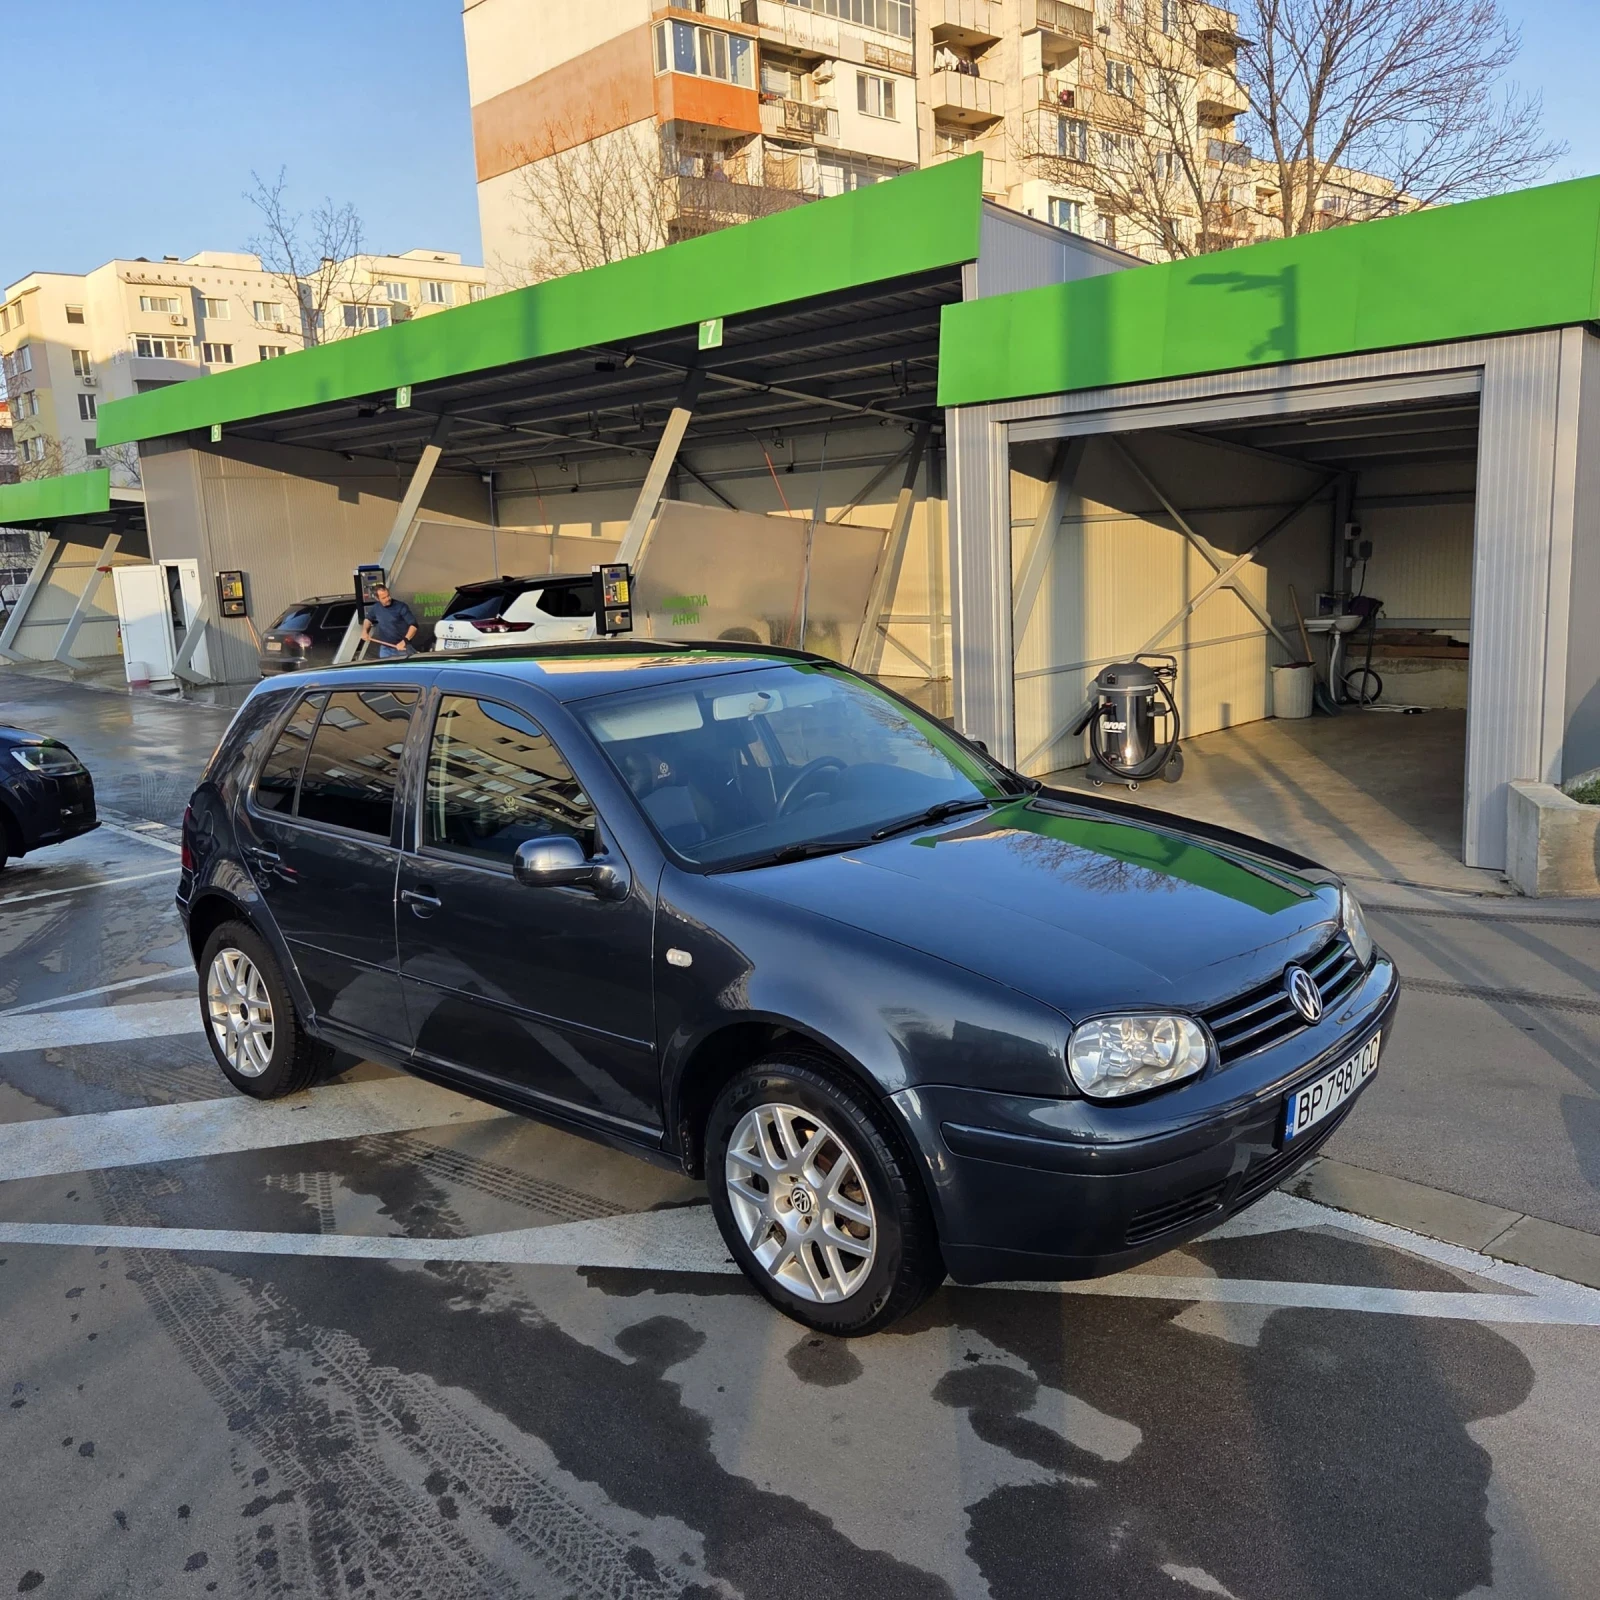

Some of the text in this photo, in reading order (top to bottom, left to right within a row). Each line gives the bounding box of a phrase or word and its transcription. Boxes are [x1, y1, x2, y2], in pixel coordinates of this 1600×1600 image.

[706, 320, 716, 344] 7
[400, 387, 407, 405] 6
[214, 424, 219, 439] 5
[1298, 1036, 1378, 1129] BP 7987 CC
